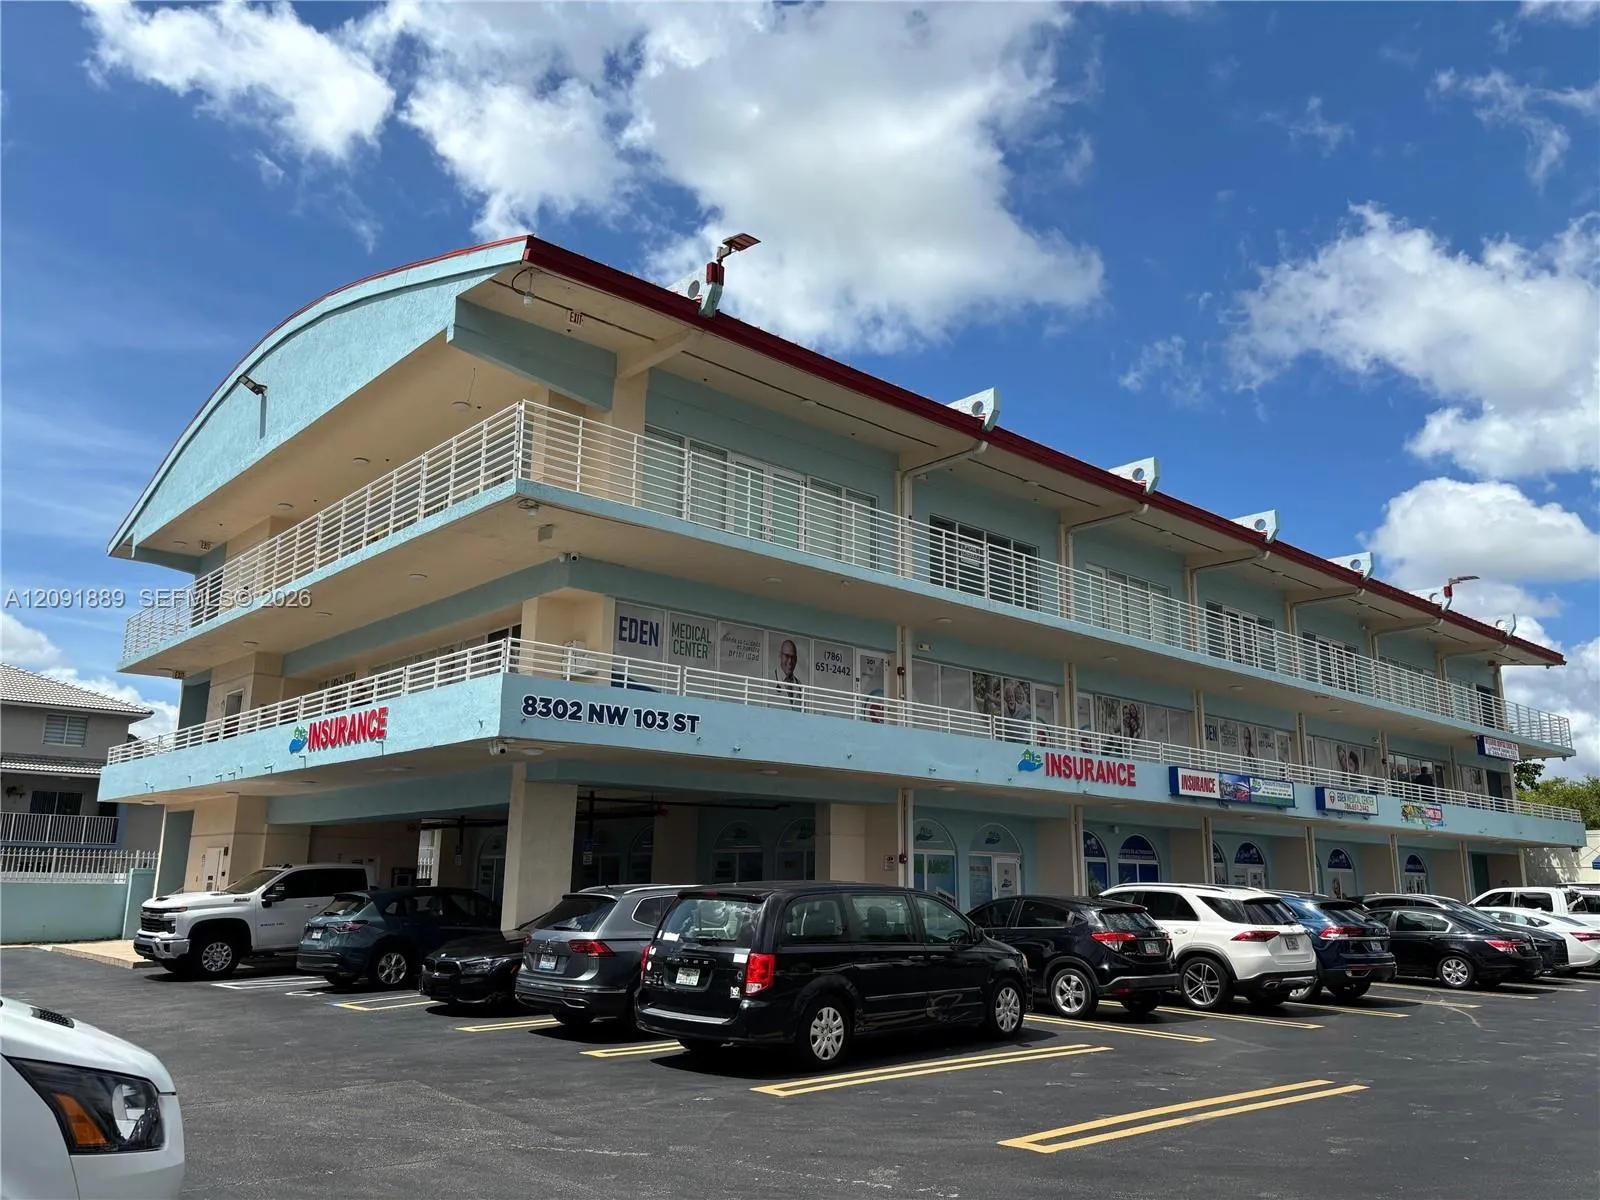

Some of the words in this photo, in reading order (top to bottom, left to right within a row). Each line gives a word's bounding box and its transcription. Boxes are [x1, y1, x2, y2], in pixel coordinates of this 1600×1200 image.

[618, 616, 659, 647] EDEN
[671, 621, 711, 644] MEDICAL
[673, 639, 708, 660] CENTER
[824, 651, 843, 663] (786)
[815, 662, 851, 676] 651-2442
[522, 695, 583, 722] 8302
[587, 703, 628, 726] NW
[633, 709, 669, 731] 103
[673, 714, 700, 733] ST
[307, 706, 389, 752] INSURANCE
[1045, 752, 1137, 787] INSURANCE
[1181, 774, 1216, 793] INSURANCE
